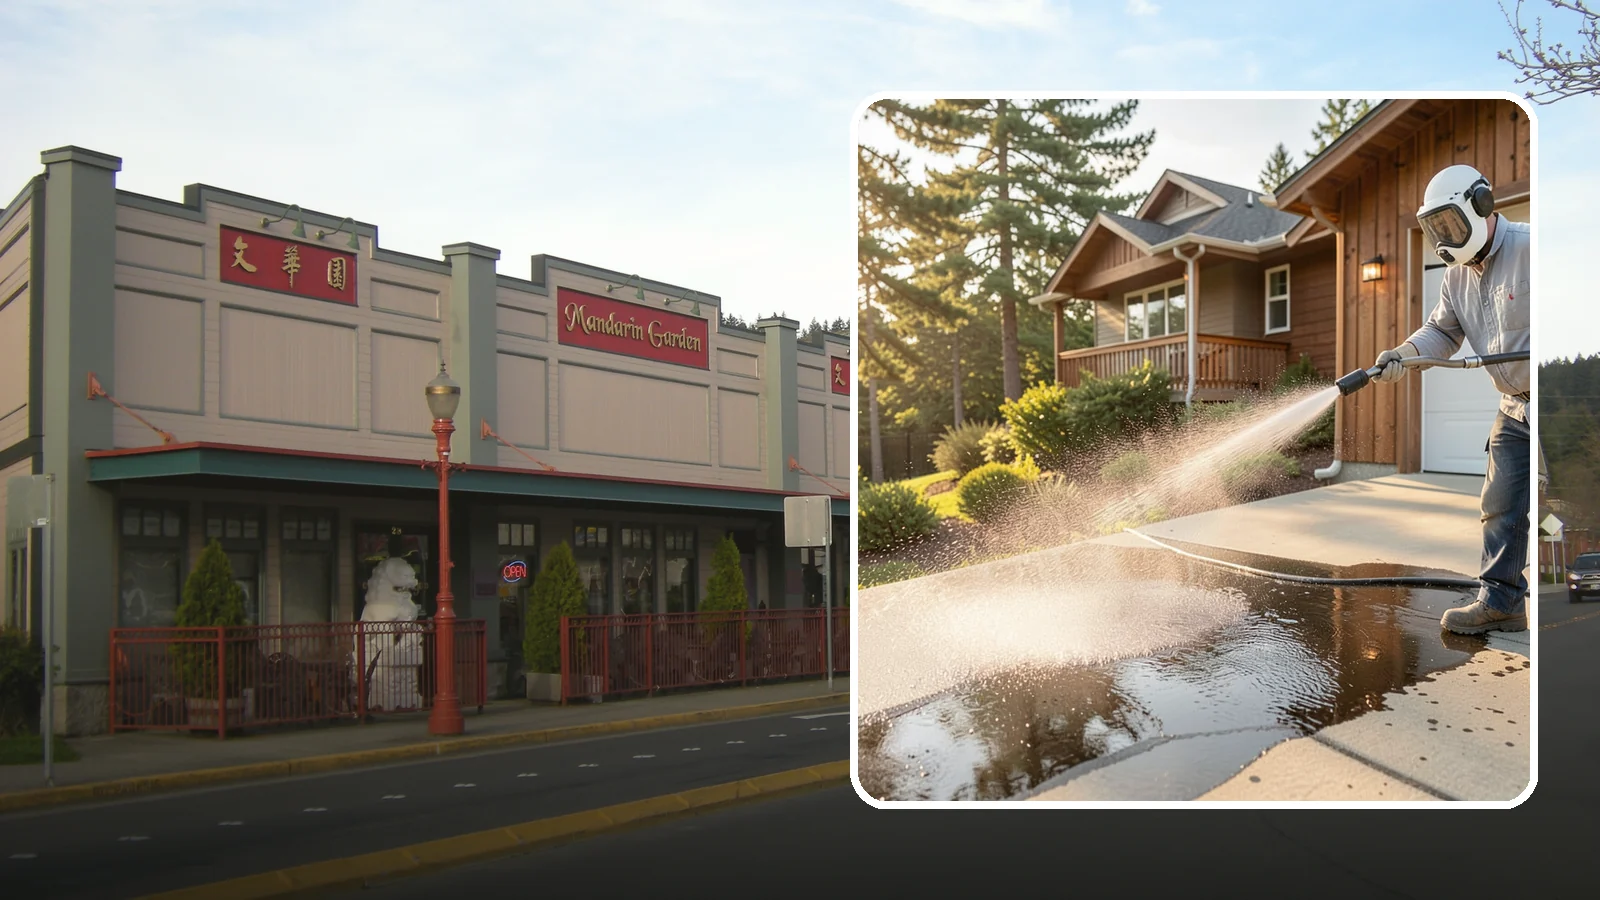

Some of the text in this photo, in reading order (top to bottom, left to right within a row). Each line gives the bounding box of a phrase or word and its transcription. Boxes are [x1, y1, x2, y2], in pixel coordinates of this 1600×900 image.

[231, 236, 346, 290] 文華園
[565, 302, 702, 352] Mandarin Garden
[503, 566, 527, 578] OPEN
